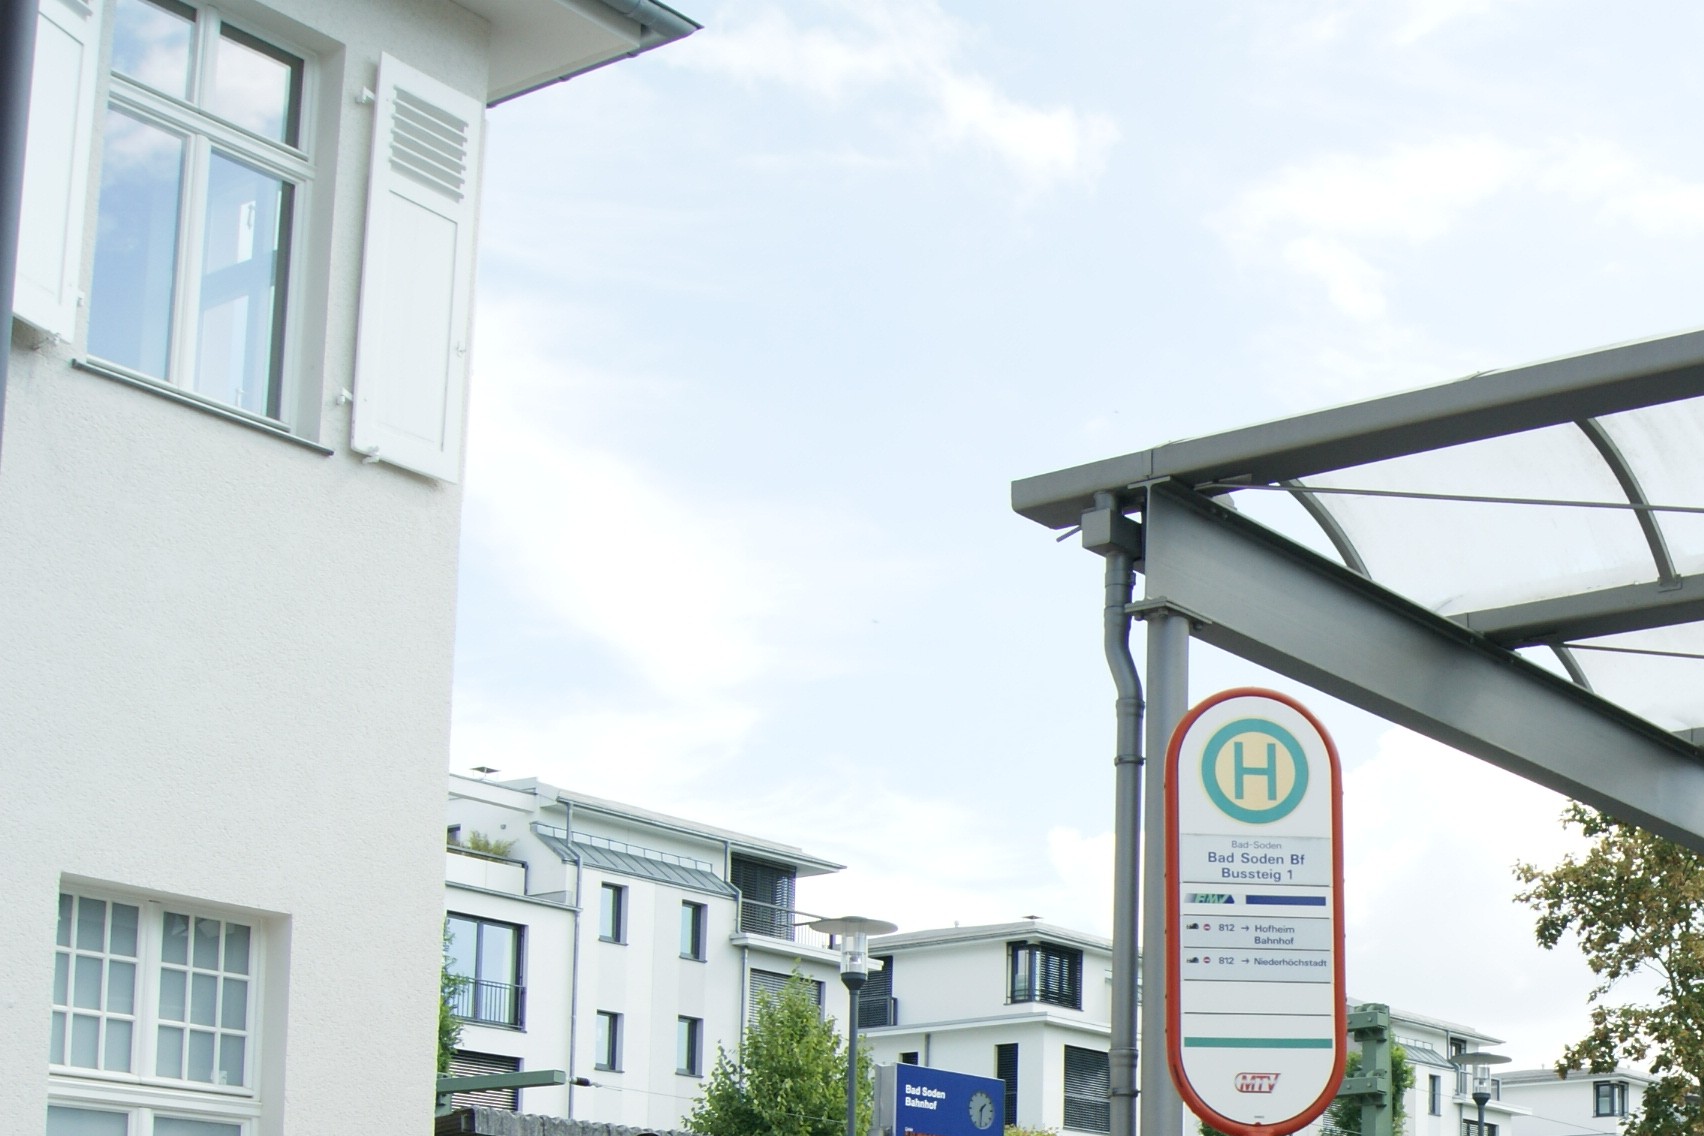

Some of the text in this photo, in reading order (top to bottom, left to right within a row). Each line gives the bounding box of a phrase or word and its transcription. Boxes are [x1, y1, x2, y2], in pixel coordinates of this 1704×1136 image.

[1234, 741, 1277, 801] H
[1207, 851, 1305, 865] Bad Soden Bf
[1221, 867, 1293, 882] Bussteig 1
[1218, 923, 1295, 934] 812 Hofheim
[1254, 936, 1294, 945] Bahnhof
[1218, 956, 1327, 967] 812 Niederhöchstadt
[905, 1084, 946, 1099] Bad Soden
[905, 1097, 937, 1111] Bahnhof
